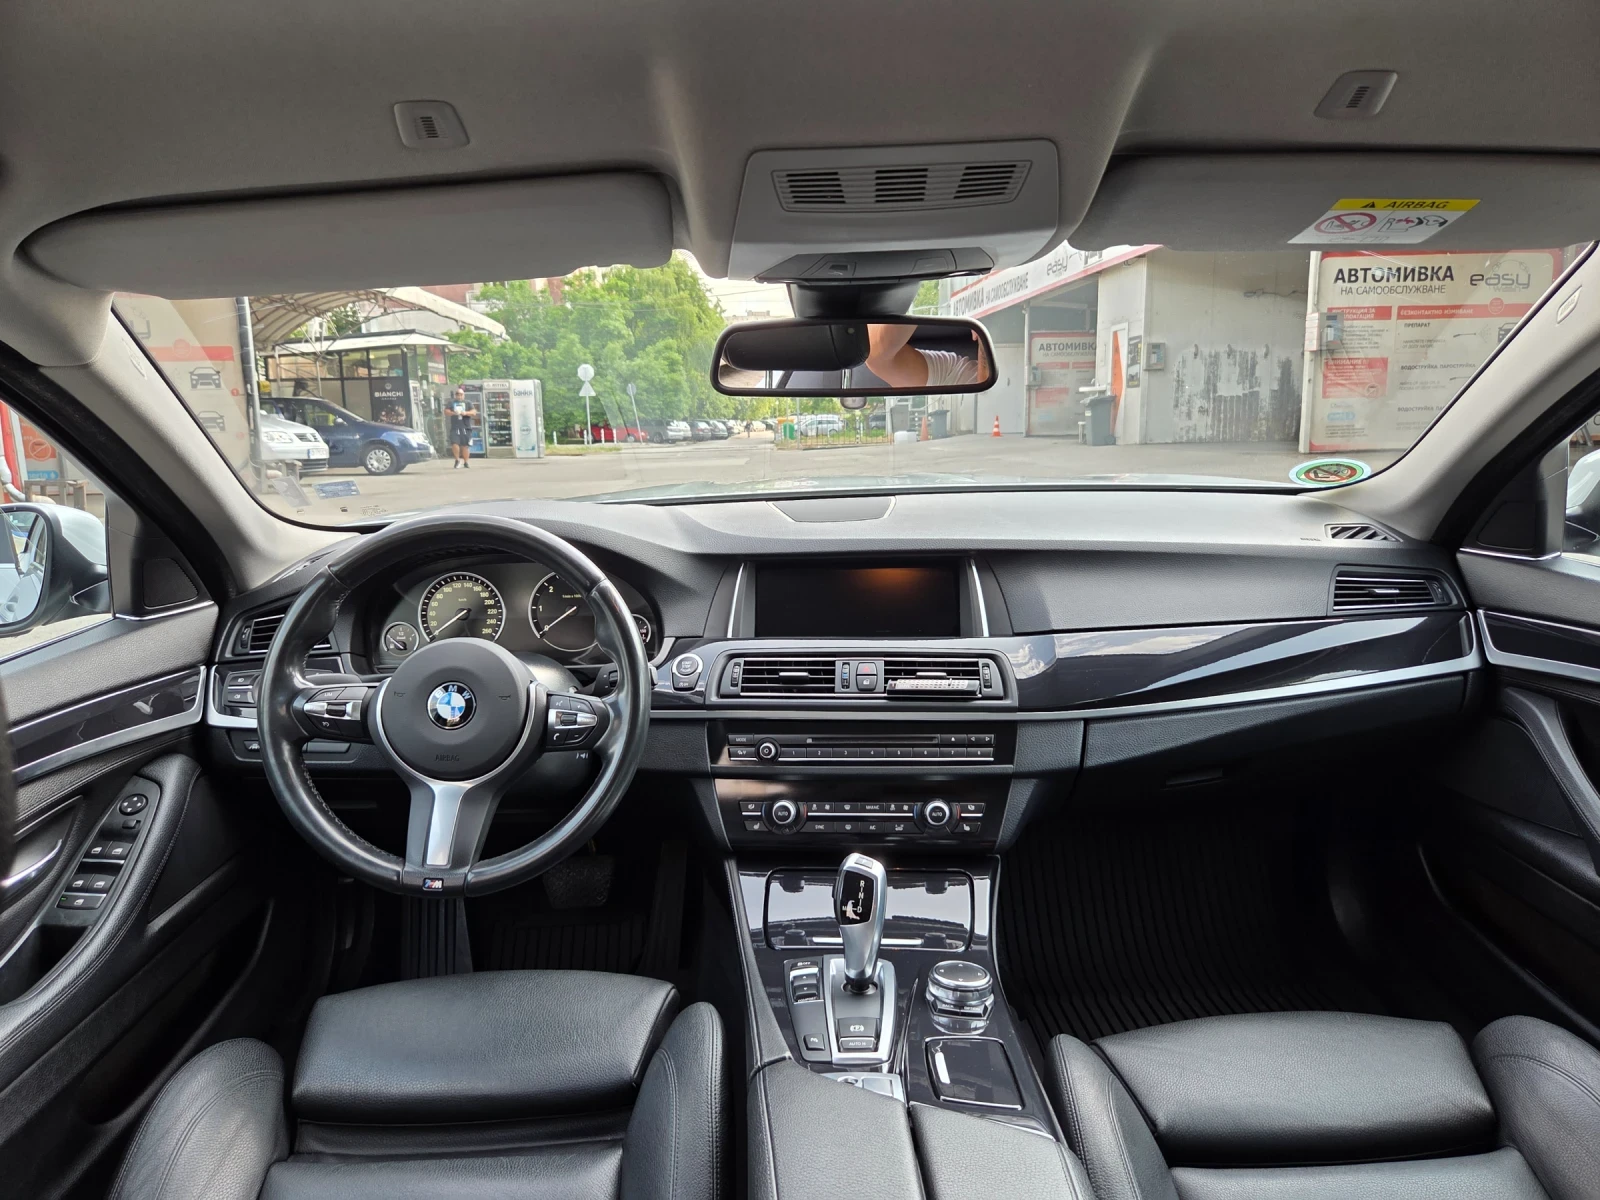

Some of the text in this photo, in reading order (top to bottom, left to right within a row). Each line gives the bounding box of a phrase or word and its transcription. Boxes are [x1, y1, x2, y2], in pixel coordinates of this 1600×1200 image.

[1384, 201, 1450, 210] AIRBAG
[1046, 255, 1068, 276] easy
[1333, 265, 1454, 284] АВТОМИВКА
[1470, 273, 1531, 289] easy
[1340, 285, 1446, 296] НА САМООБСЛУЖВАНЕ
[434, 684, 471, 700] BMW
